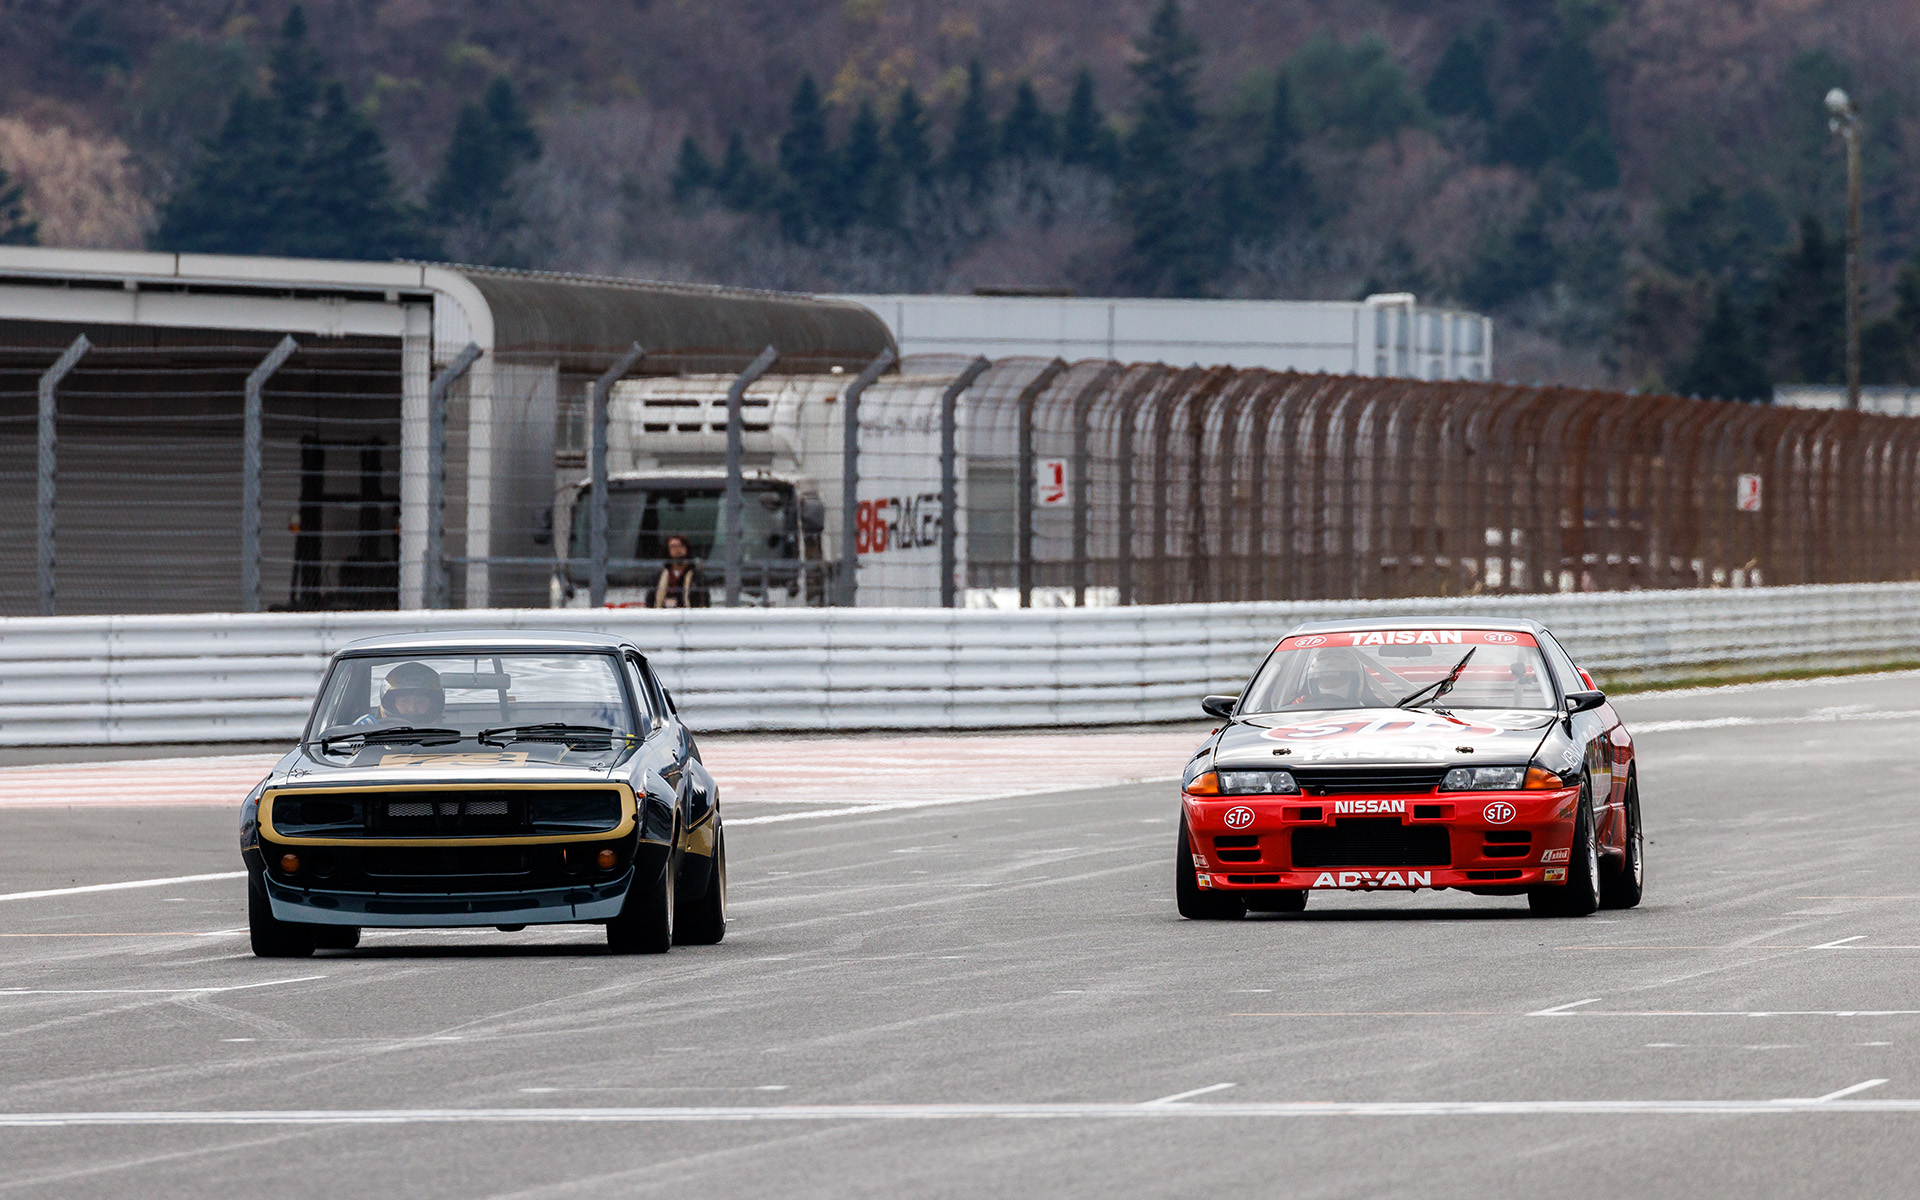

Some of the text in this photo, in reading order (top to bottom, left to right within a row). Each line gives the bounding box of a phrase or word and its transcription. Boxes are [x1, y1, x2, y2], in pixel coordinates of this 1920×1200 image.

[1297, 636, 1323, 647] STP
[1350, 630, 1462, 646] TAISAN
[1488, 632, 1514, 643] STP
[1285, 713, 1467, 738] STP
[1335, 800, 1405, 813] NISSAN
[1487, 804, 1511, 820] STP
[1227, 809, 1251, 825] STP
[1312, 871, 1431, 887] ADVAN
